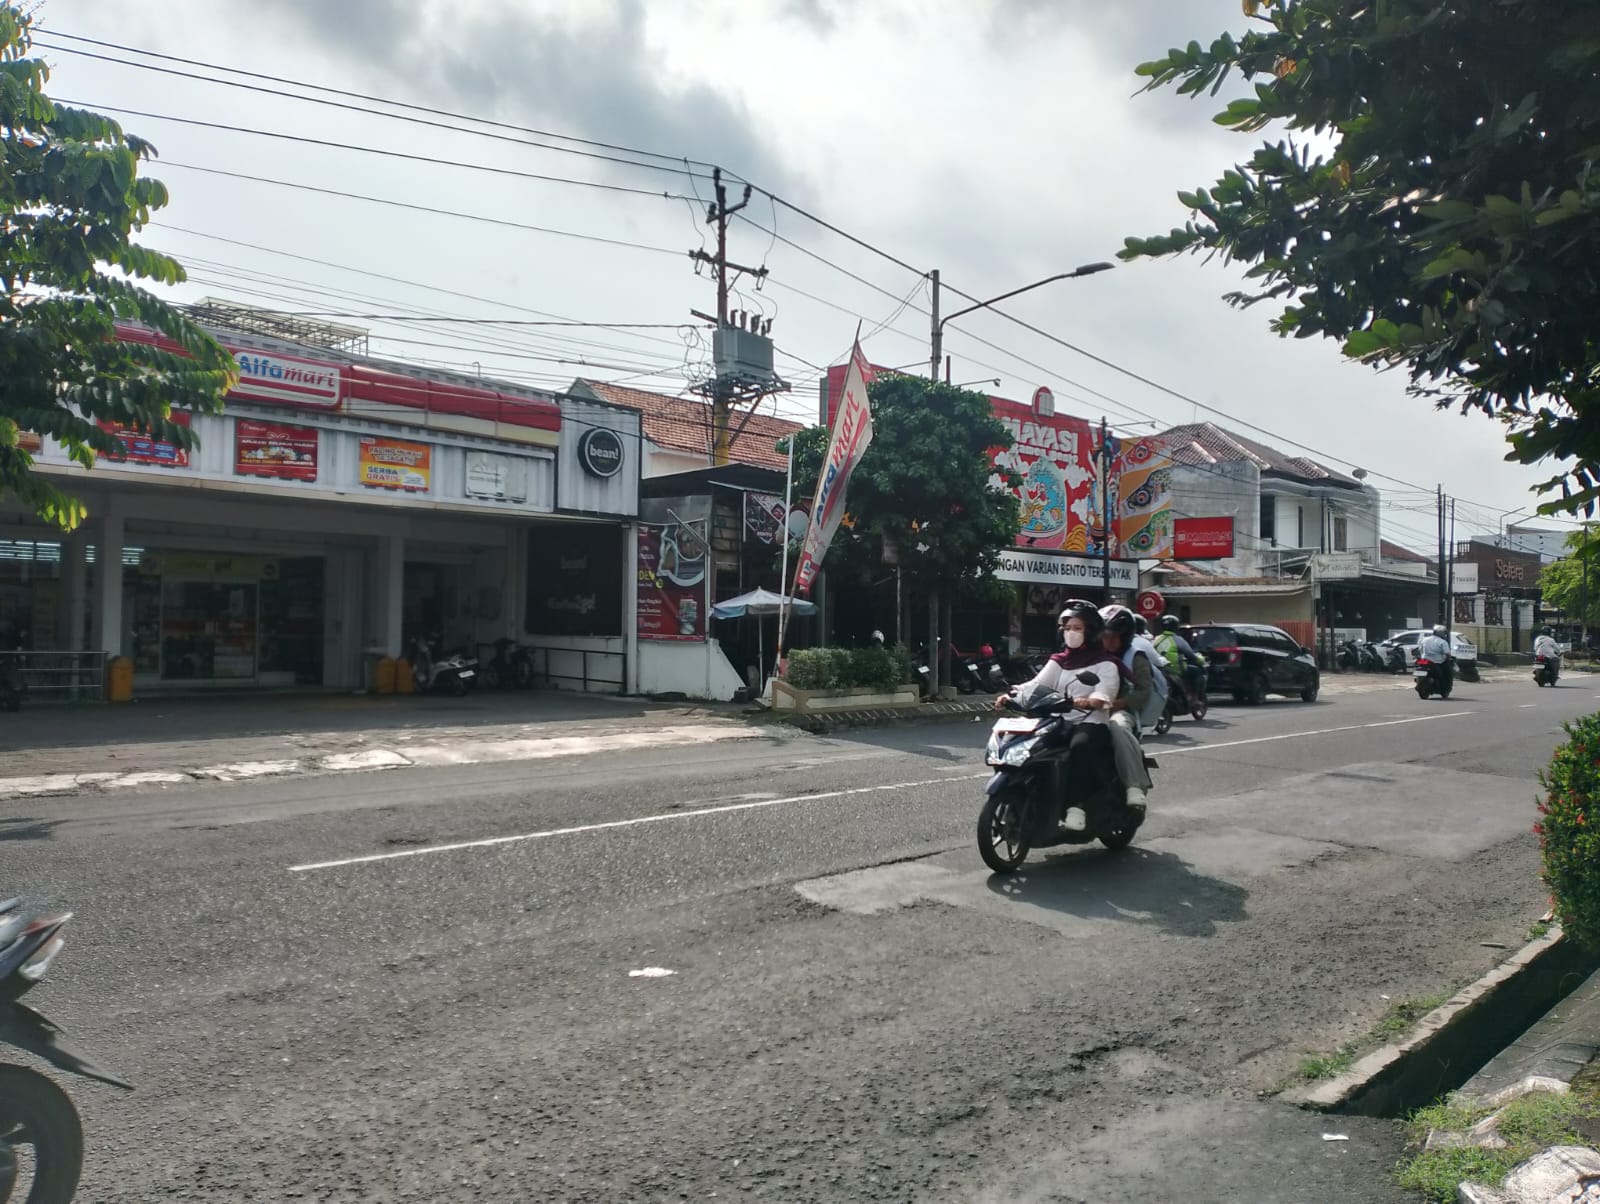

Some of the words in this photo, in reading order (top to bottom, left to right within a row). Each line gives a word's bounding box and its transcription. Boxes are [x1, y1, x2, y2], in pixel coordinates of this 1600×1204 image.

[239, 355, 335, 387] Alfamart
[589, 443, 619, 460] bean!
[1026, 560, 1059, 576] VARIAN
[1060, 563, 1087, 577] BENTO
[1087, 565, 1132, 580] TERNYAK
